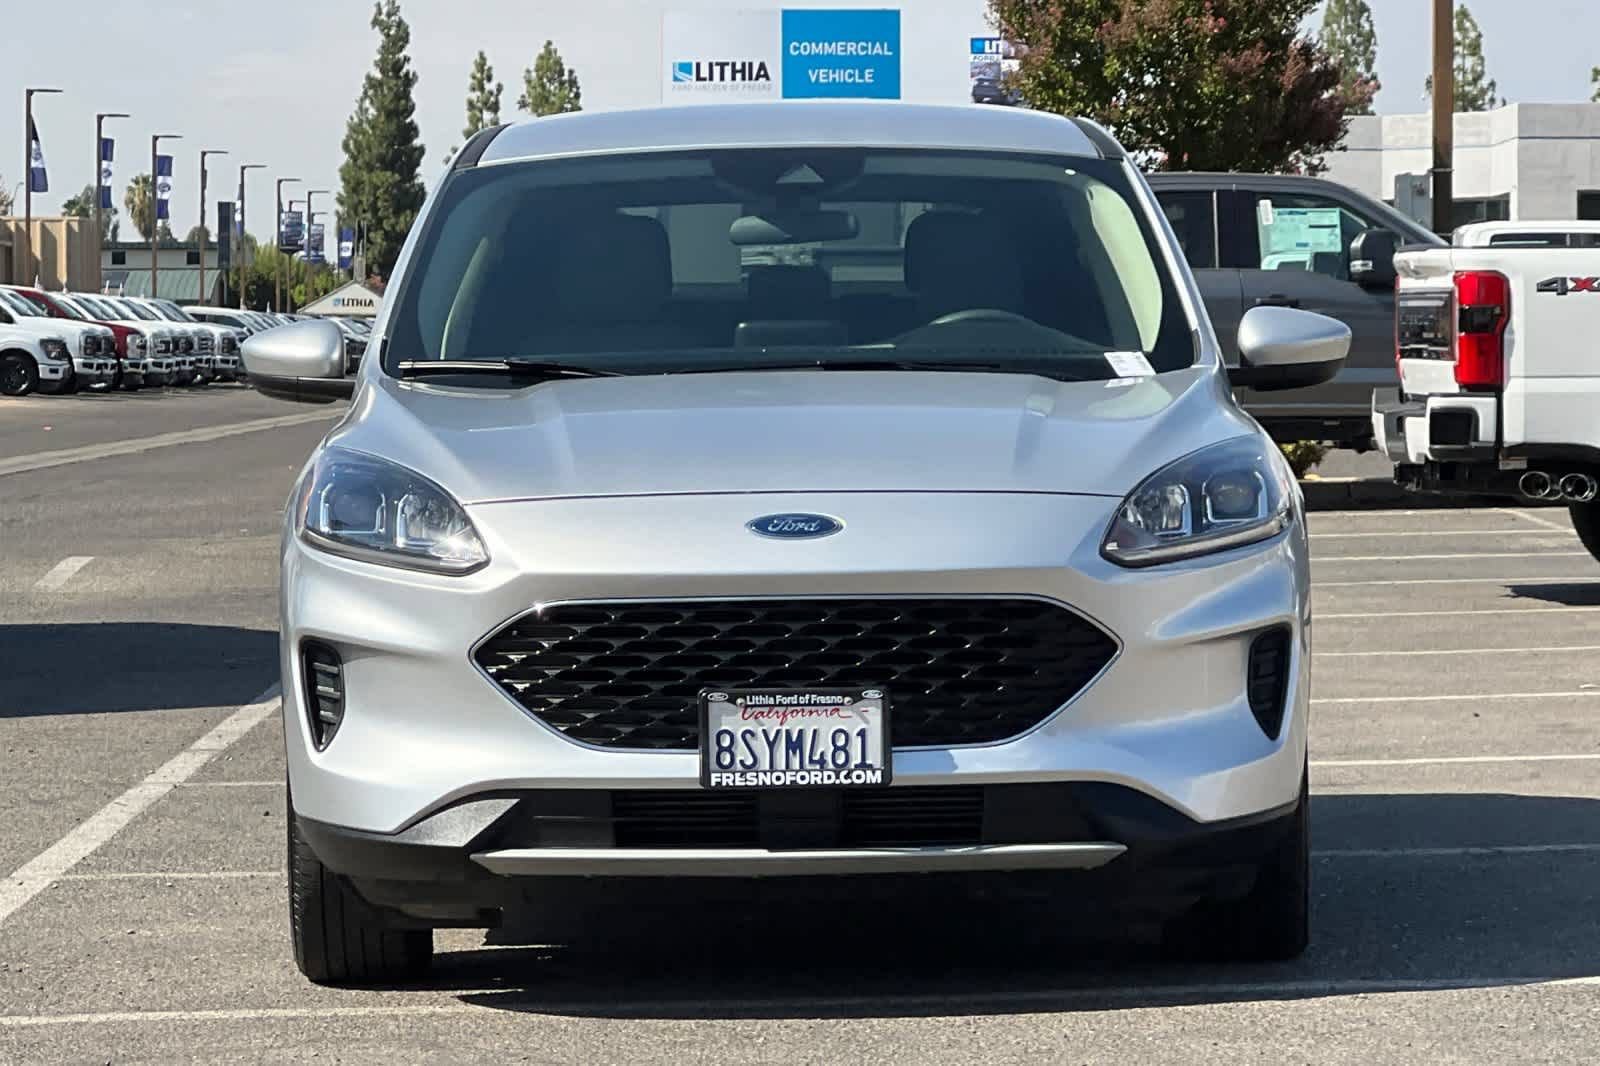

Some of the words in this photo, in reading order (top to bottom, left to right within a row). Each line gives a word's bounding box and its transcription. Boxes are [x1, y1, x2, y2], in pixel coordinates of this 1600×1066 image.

[789, 41, 893, 56] COMMERCIAL
[695, 61, 770, 82] LITHIA
[808, 69, 875, 84] VEHICLE
[1536, 277, 1600, 296] 4X
[342, 298, 374, 307] LITHIA
[746, 695, 774, 705] Lithia
[776, 695, 797, 705] Ford
[799, 695, 810, 704] of
[810, 695, 843, 704] Fresno
[741, 706, 853, 725] California
[715, 728, 873, 770] 8SYM481
[711, 770, 882, 786] FRESNOFORD.COM
